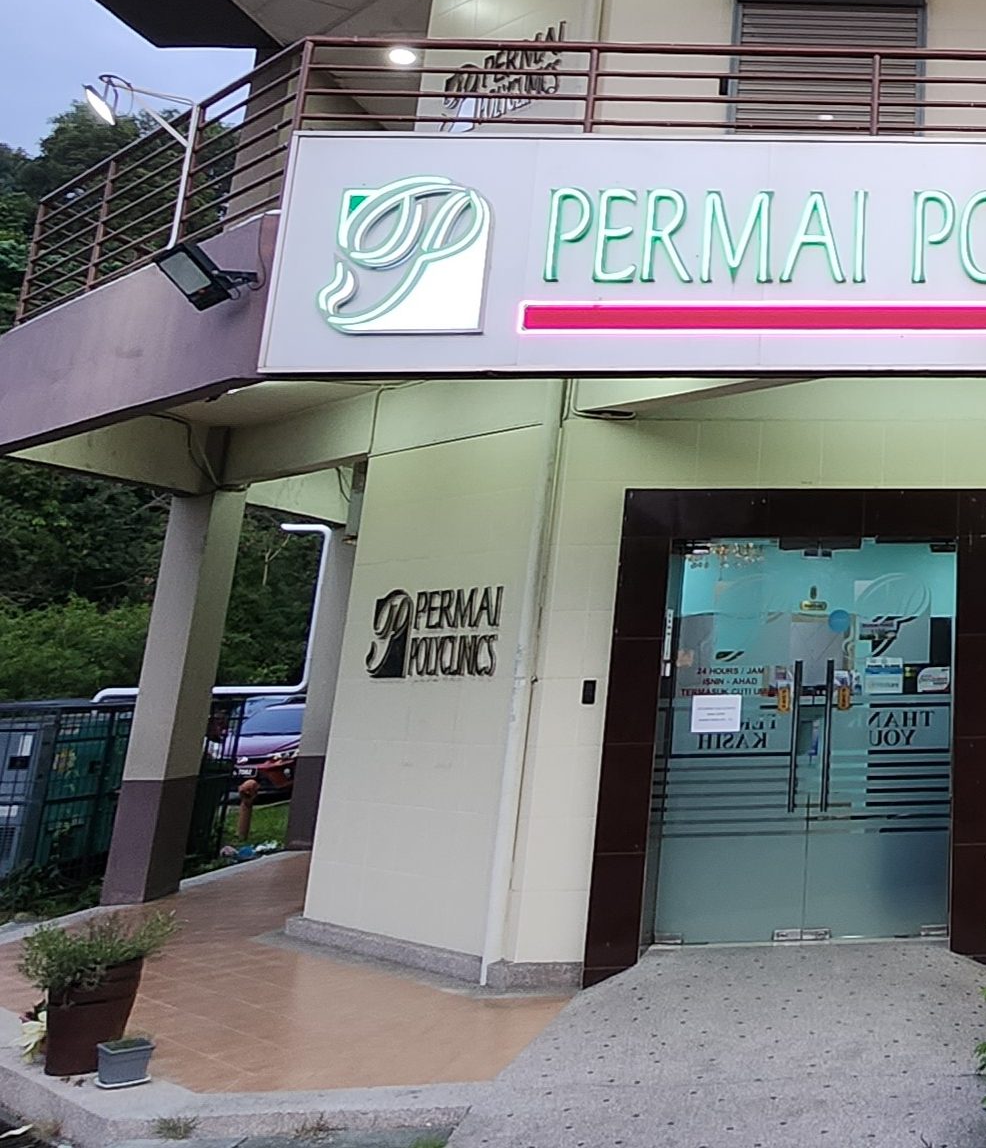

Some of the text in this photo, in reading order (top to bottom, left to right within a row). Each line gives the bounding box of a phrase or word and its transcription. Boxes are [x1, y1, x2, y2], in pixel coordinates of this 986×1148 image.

[543, 187, 869, 283] PERMAI
[414, 586, 504, 630] PERMAI
[709, 667, 739, 675] HOURS
